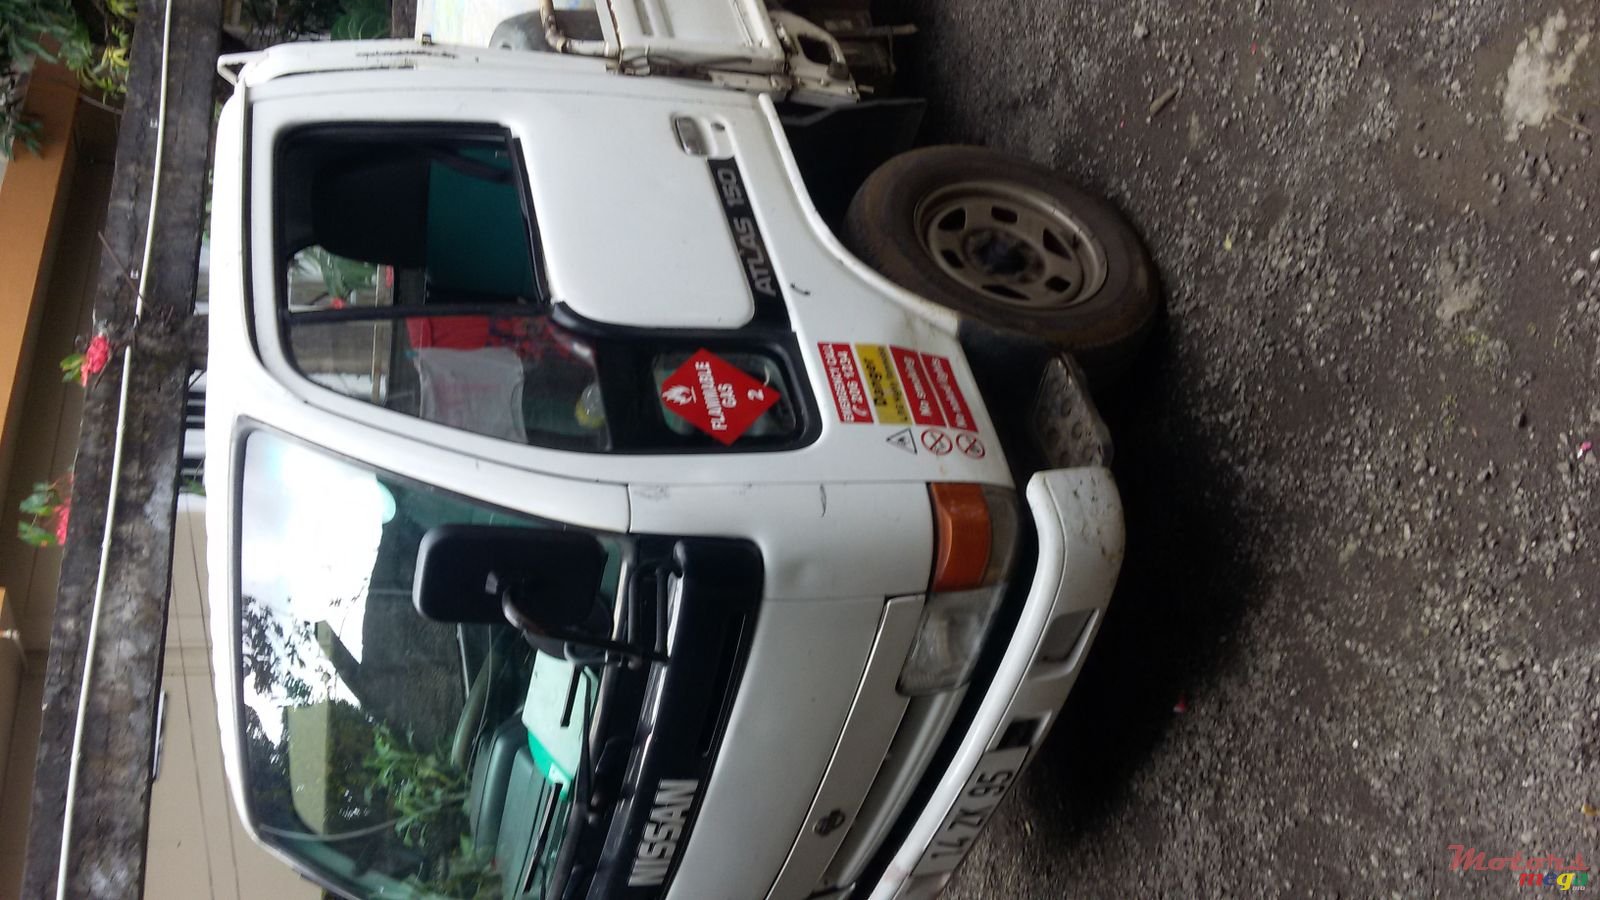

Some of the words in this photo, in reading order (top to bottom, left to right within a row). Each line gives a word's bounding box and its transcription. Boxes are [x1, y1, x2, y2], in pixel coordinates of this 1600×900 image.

[717, 168, 745, 207] 150
[733, 217, 777, 297] ATLAS
[695, 361, 727, 430] FLAMMABLE
[718, 383, 737, 408] GAS
[747, 389, 765, 401] 2
[967, 770, 1014, 798] 95
[627, 779, 700, 887] NISSAN
